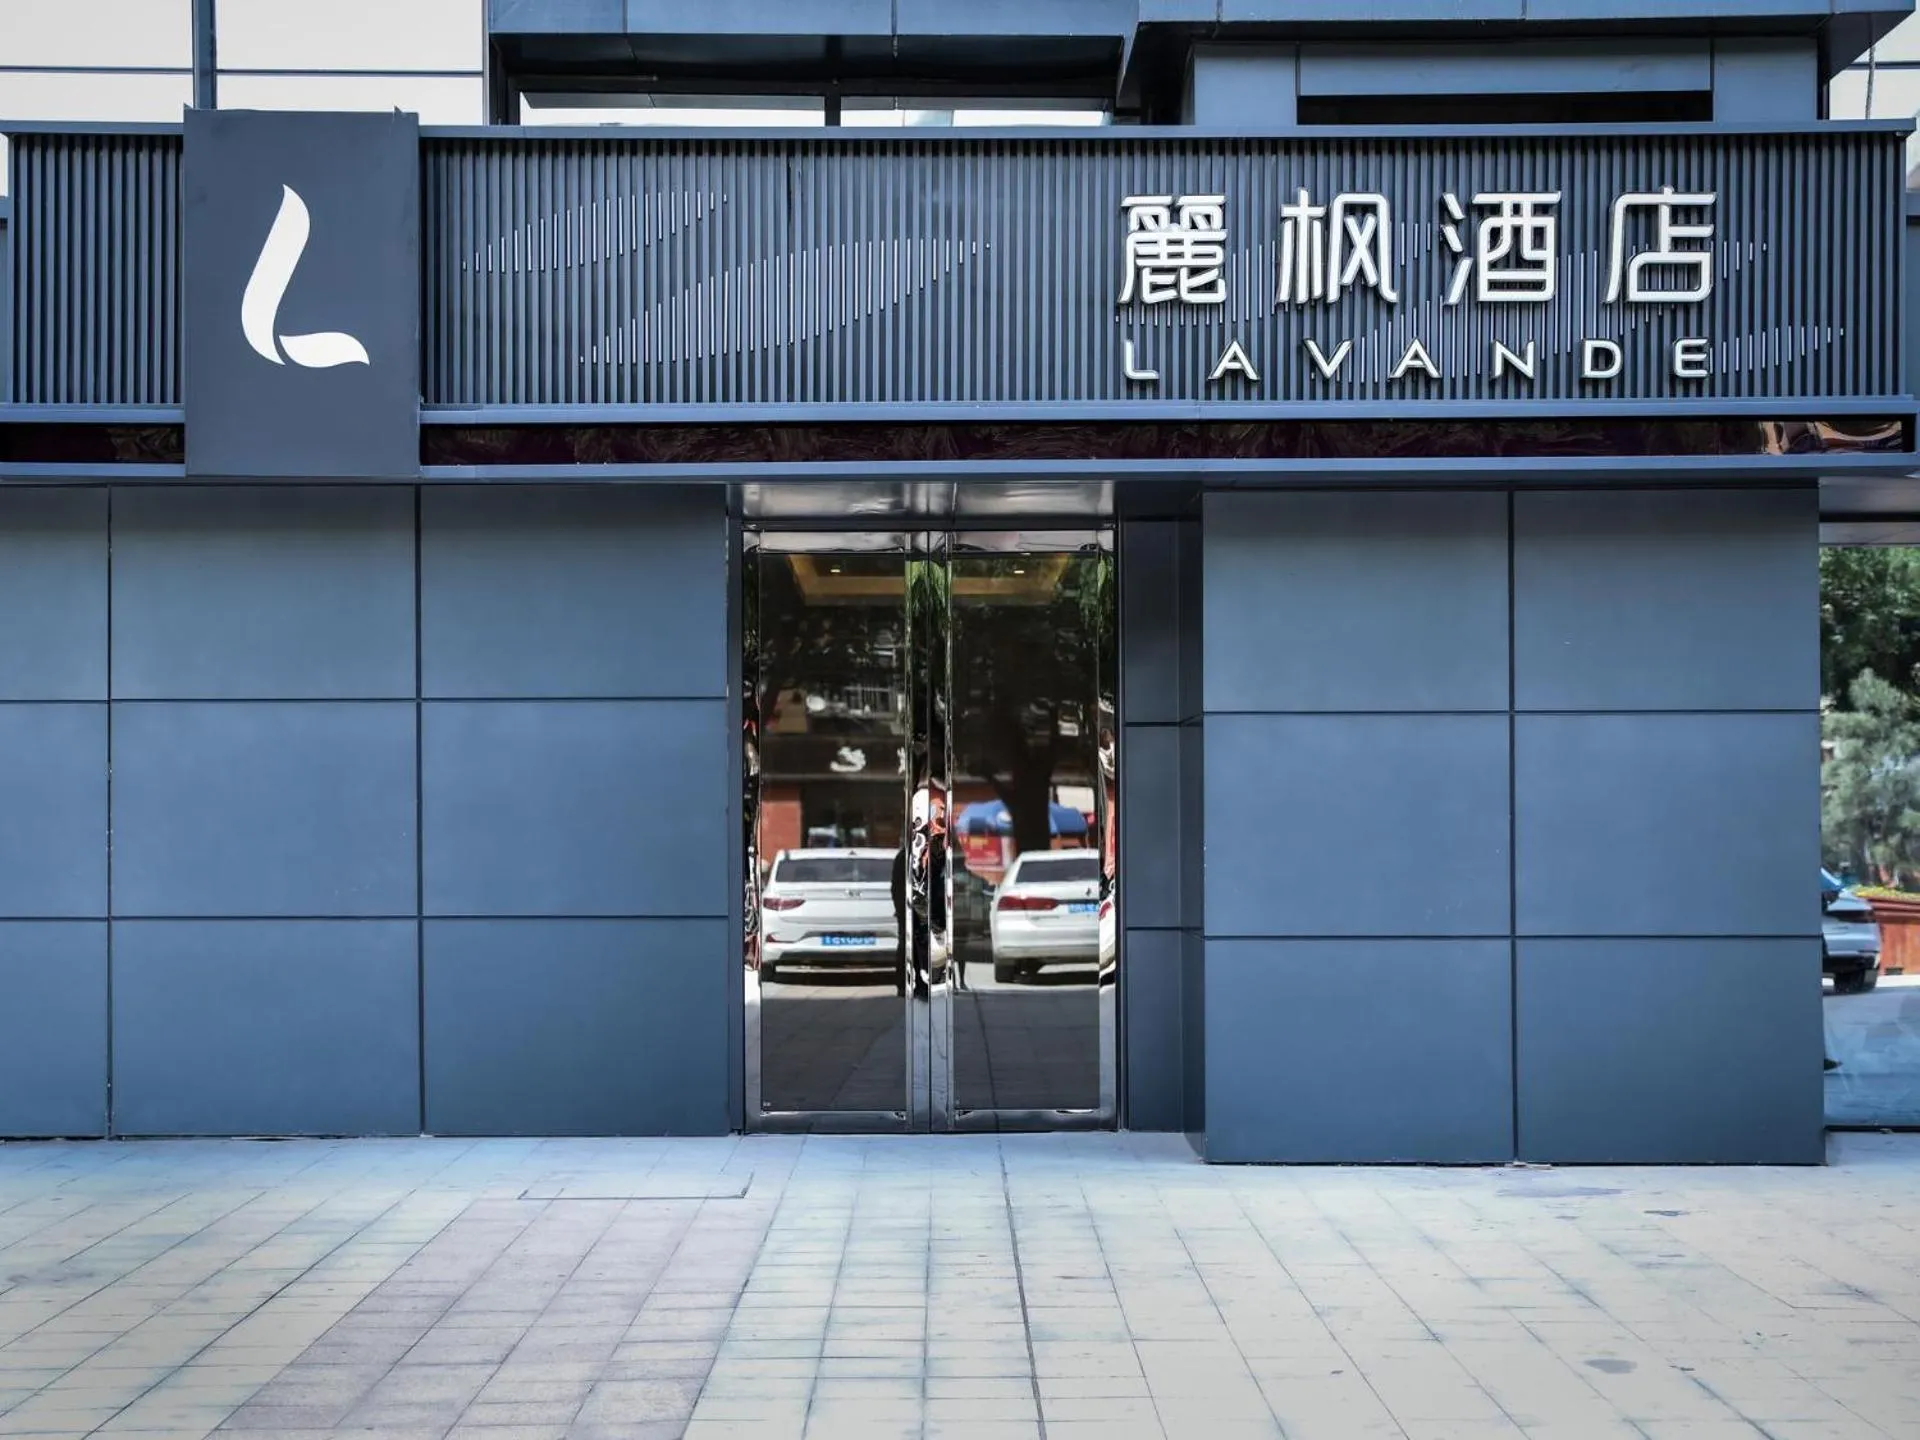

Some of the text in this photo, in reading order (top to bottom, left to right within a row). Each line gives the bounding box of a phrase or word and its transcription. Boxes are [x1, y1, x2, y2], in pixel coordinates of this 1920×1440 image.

[1119, 187, 1717, 306] 麗枫酒店
[1124, 338, 1710, 380] LAVANDE
